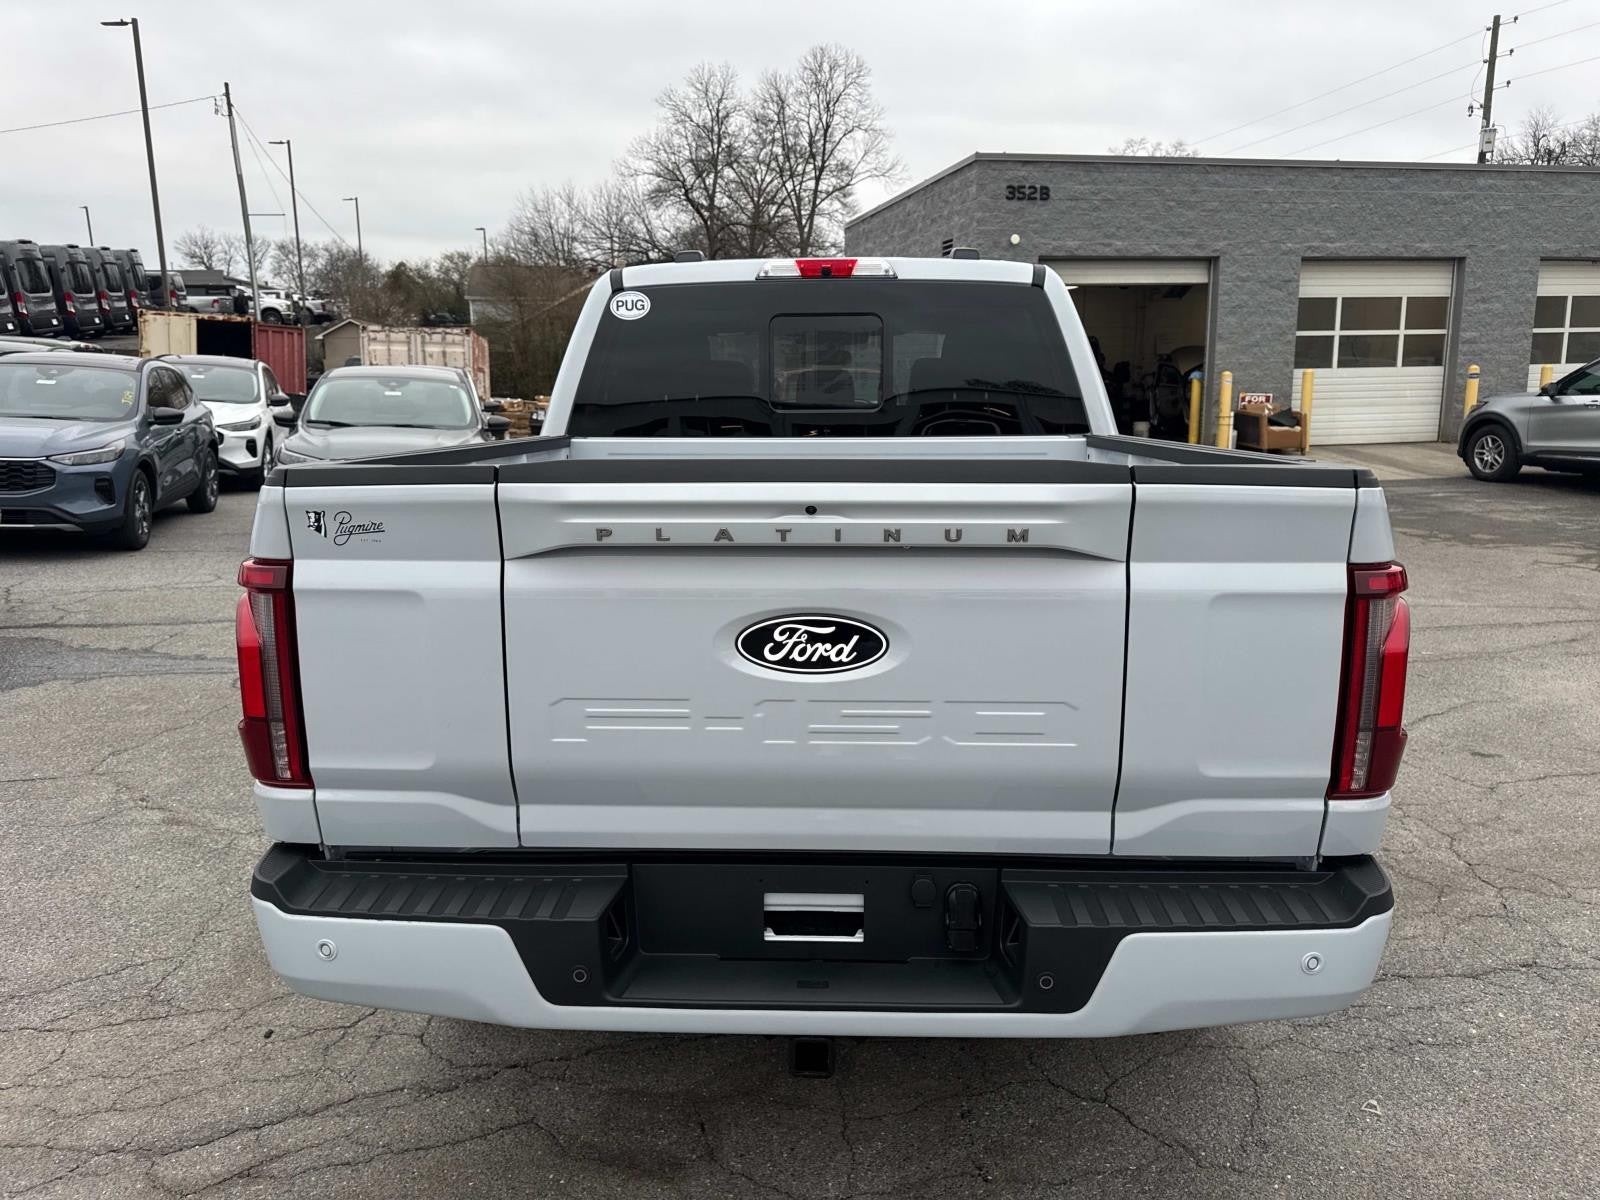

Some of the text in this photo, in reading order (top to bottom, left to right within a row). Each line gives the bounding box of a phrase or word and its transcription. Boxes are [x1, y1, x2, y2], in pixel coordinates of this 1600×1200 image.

[1005, 185, 1051, 201] 352B
[615, 299, 646, 312] PUG
[1244, 395, 1266, 403] FOR
[333, 510, 386, 547] Pugmire
[595, 526, 1030, 543] PLATINUM
[762, 622, 858, 664] Ford
